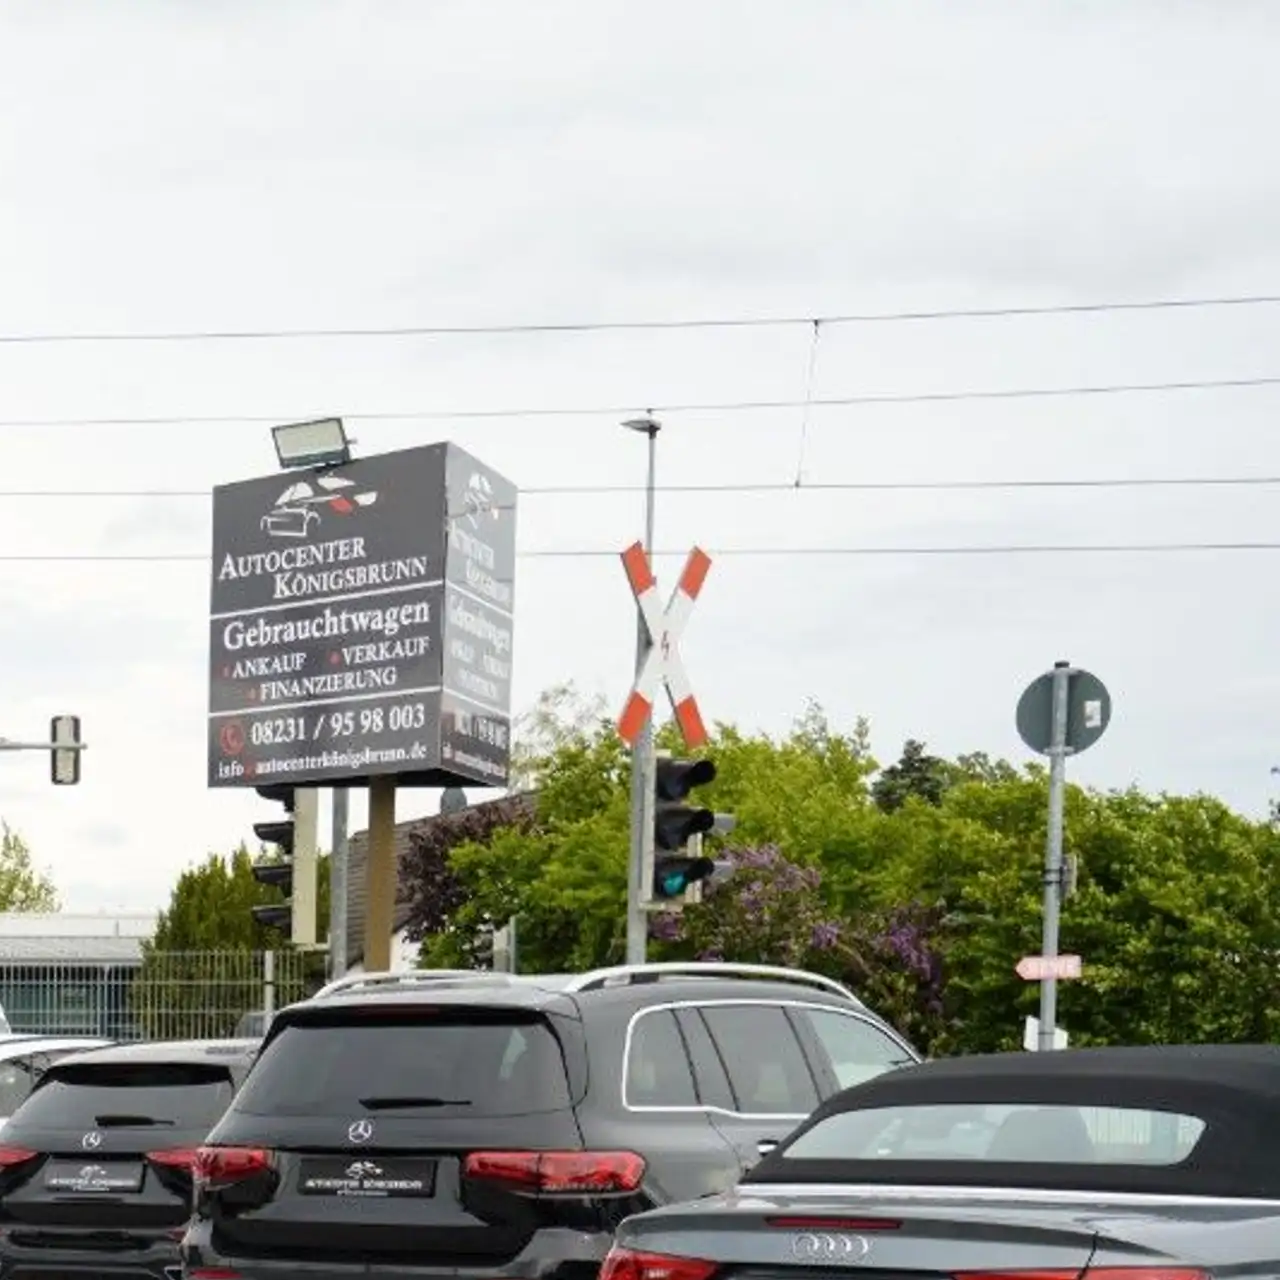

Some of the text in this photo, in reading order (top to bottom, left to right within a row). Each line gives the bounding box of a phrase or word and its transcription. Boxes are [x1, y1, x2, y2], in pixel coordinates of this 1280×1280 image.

[218, 537, 366, 580] AUTOCENTER
[273, 556, 428, 599] KÖNIGSBRUNN
[224, 601, 429, 650] Gebrauchtwagen
[232, 653, 307, 678] ANKAUF
[342, 636, 430, 666] VERKAUF
[260, 667, 397, 701] FINANZIERUNG
[250, 717, 306, 746] 08231
[330, 712, 354, 737] 95
[360, 709, 384, 732] 98
[390, 704, 424, 731] 003
